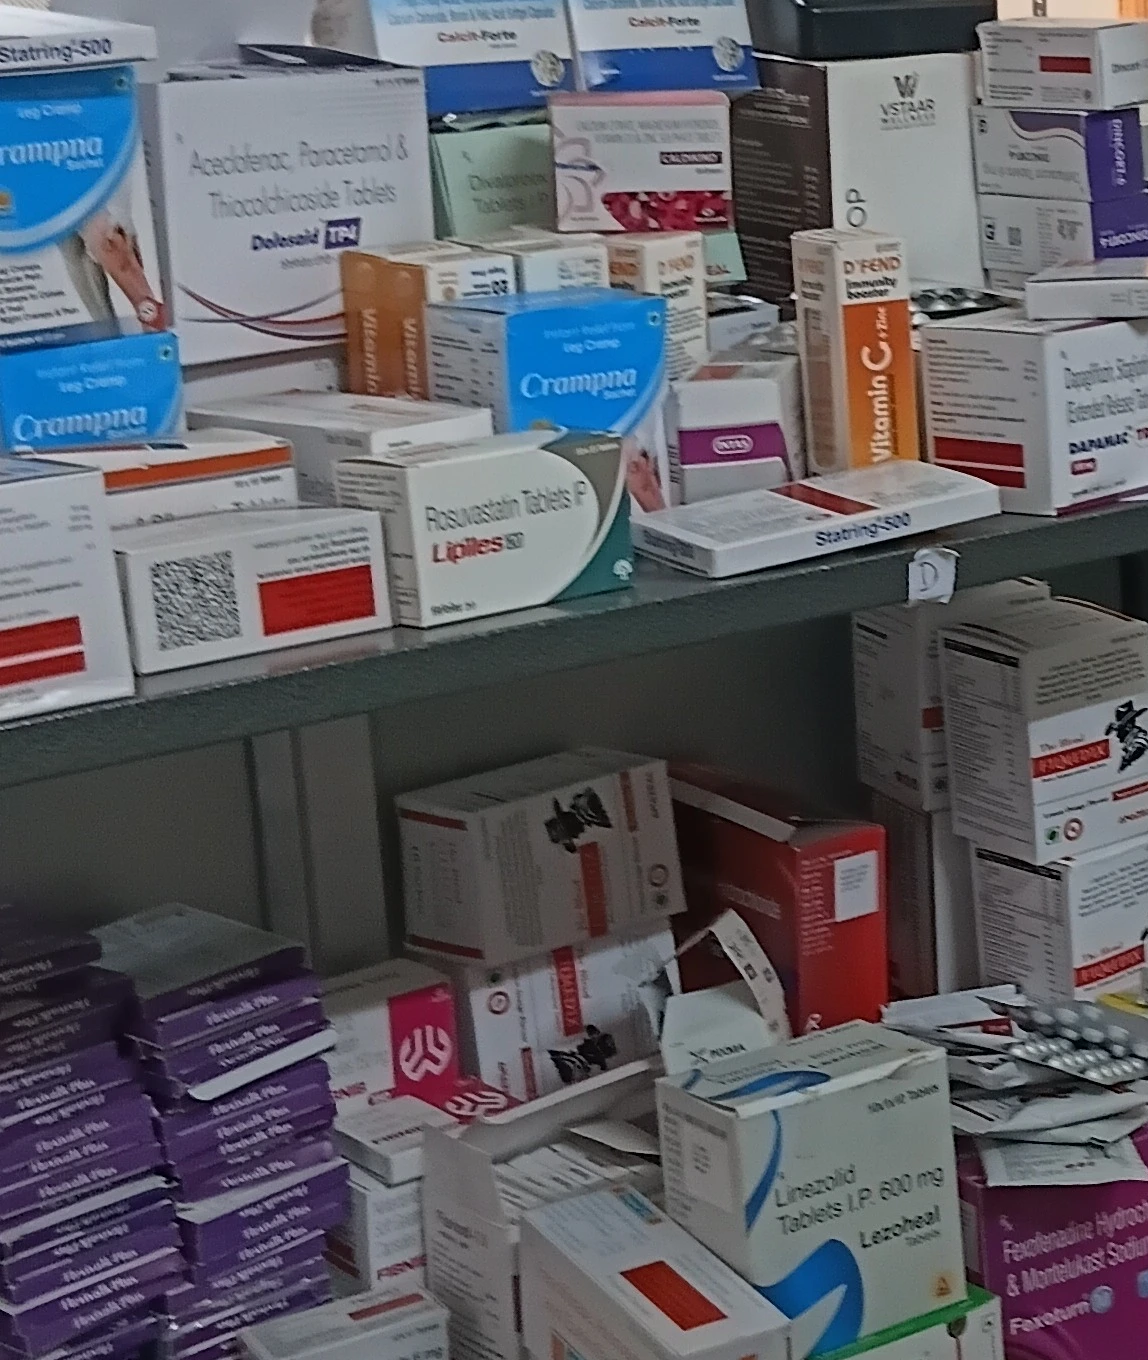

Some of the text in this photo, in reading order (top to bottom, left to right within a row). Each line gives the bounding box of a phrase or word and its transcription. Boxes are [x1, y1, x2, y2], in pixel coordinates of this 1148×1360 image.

[880, 99, 936, 118] VSTAAR
[0, 135, 104, 168] rampna
[299, 135, 391, 166] Paracetamol
[343, 182, 398, 209] Tablets
[843, 256, 902, 276] D'FEND
[860, 345, 893, 373] C
[520, 367, 637, 401] Crampna
[13, 405, 148, 442] Crampna
[870, 370, 888, 462] Vitamin
[425, 493, 520, 532] Rosuvastatin
[522, 487, 571, 517] Tablets
[814, 512, 911, 546] Statring-500
[774, 1162, 857, 1209] Linezolid
[775, 1200, 843, 1237] Tablets
[879, 1172, 914, 1203] 600
[916, 1164, 945, 1194] mg
[859, 1203, 942, 1251] Lezoheal
[1006, 1273, 1020, 1297] &
